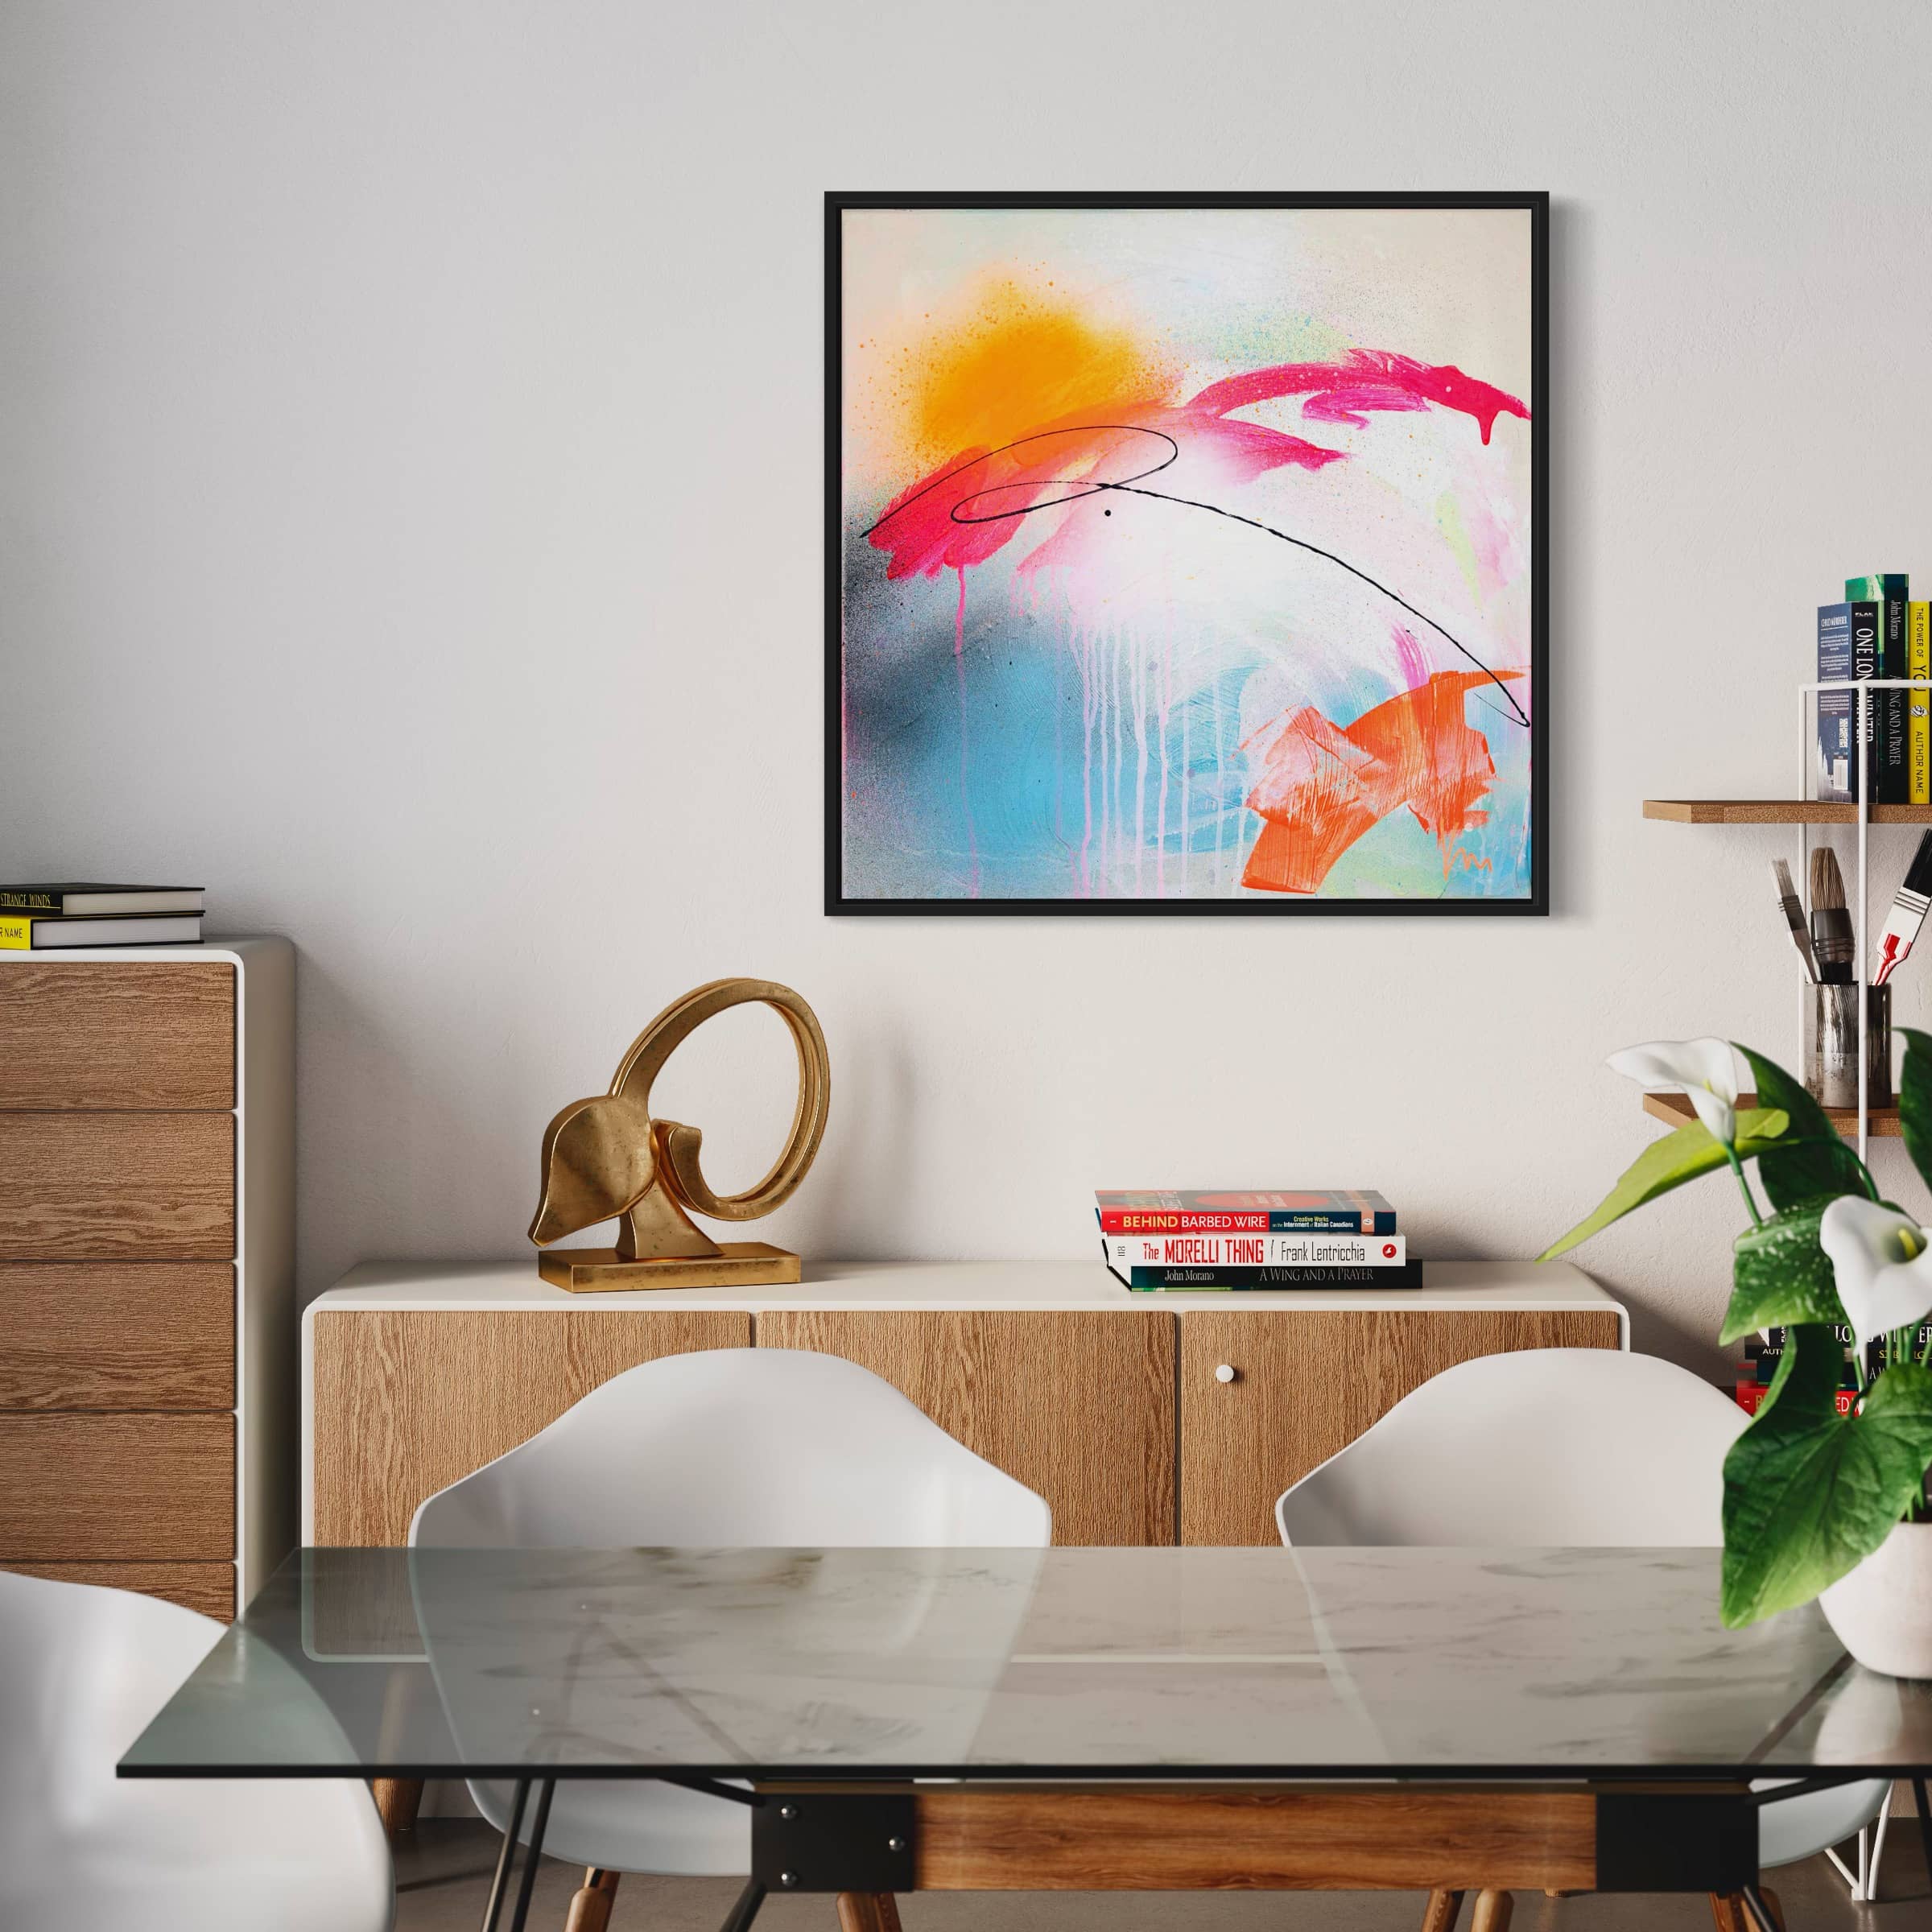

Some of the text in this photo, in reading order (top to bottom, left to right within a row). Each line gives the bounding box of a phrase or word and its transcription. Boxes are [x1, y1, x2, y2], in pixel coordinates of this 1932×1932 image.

[1916, 608, 1924, 621] THE
[1856, 628, 1874, 654] ONE
[1916, 623, 1924, 646] POWER
[1916, 650, 1924, 658] OF
[1889, 737, 1902, 766] PRAYER
[1915, 731, 1924, 794] AUTHOR NAME
[1, 894, 51, 907] STRANGE WINDS
[5, 927, 23, 939] NAME
[1123, 1216, 1266, 1228] BEHIND BARBED WIRE
[1142, 1242, 1159, 1260] The
[1165, 1239, 1219, 1263] MORELLI
[1225, 1239, 1264, 1263] THING
[1281, 1241, 1308, 1261] Frank
[1311, 1241, 1365, 1261] Lentricchia
[1165, 1269, 1215, 1282] John Morano
[1259, 1267, 1268, 1282] A
[1302, 1268, 1326, 1281] AND
[1328, 1269, 1335, 1281] A
[1338, 1266, 1374, 1281] PRAYER
